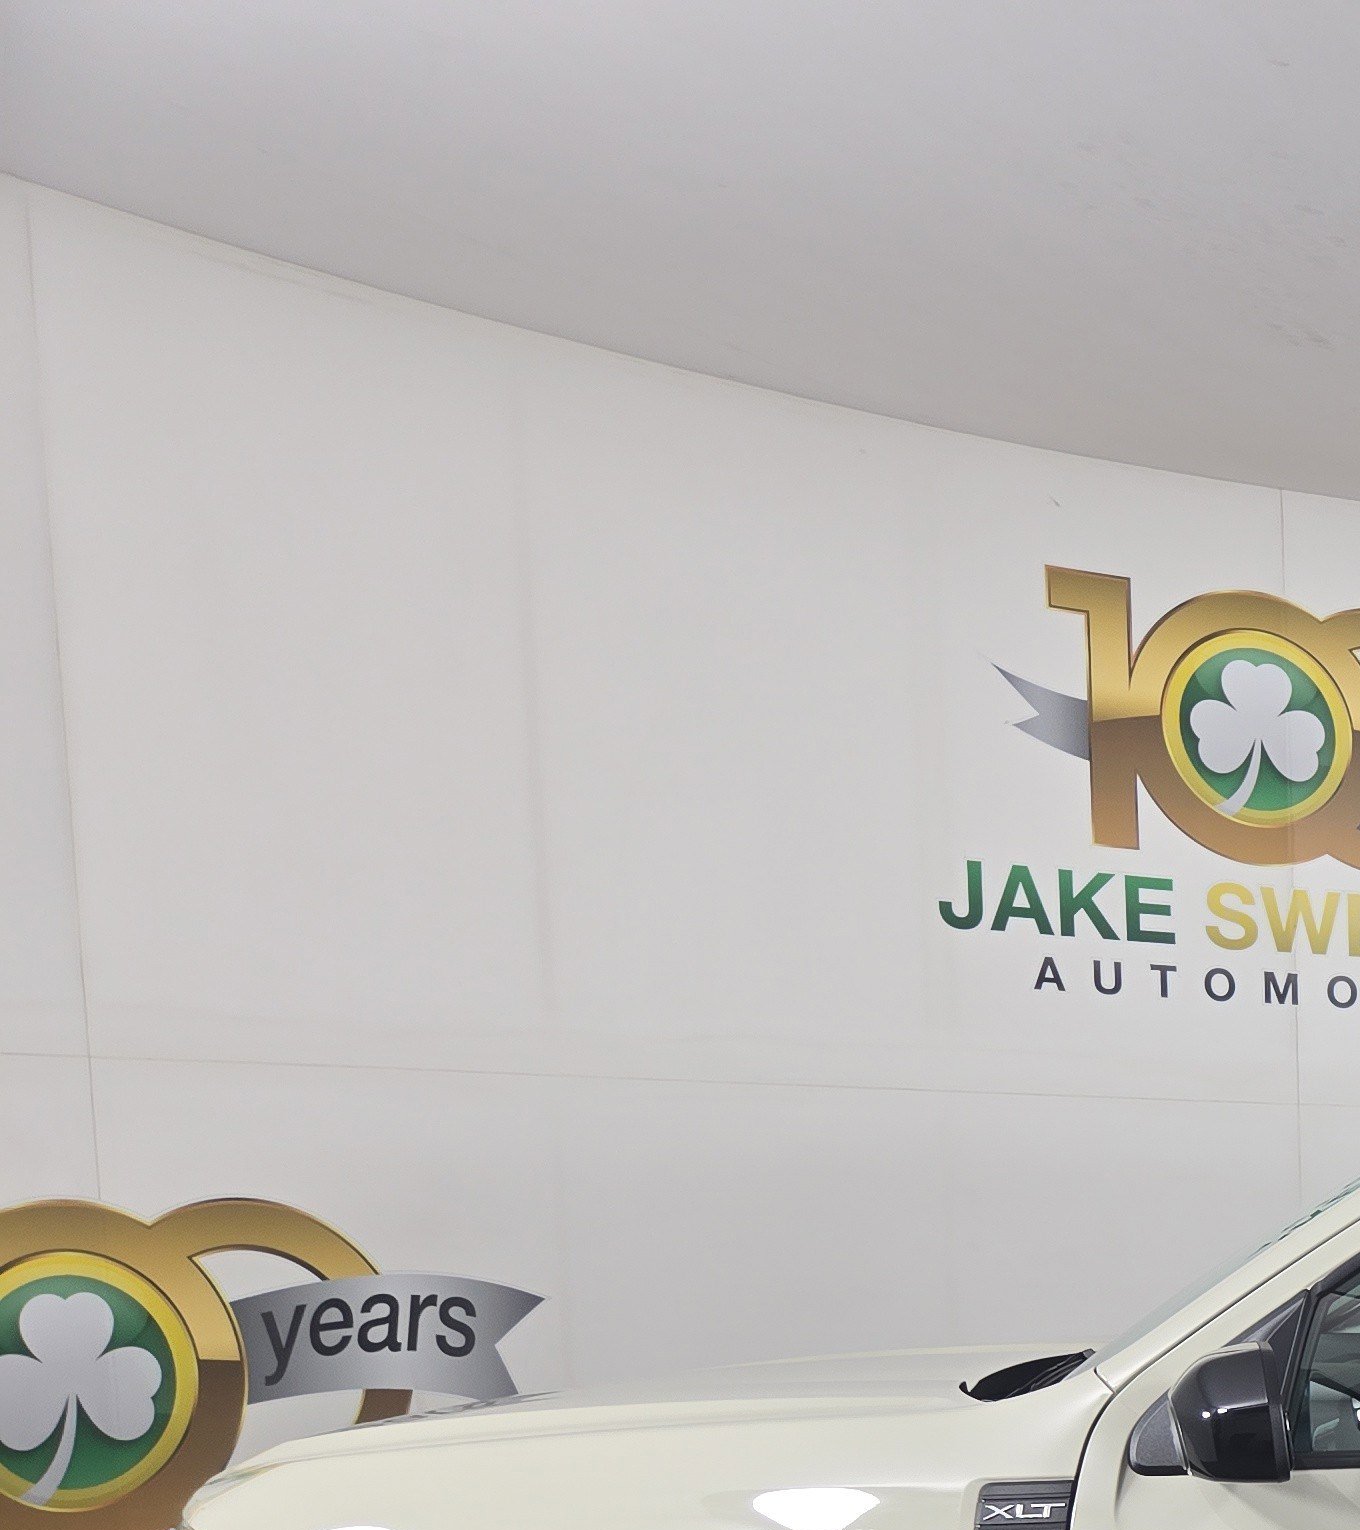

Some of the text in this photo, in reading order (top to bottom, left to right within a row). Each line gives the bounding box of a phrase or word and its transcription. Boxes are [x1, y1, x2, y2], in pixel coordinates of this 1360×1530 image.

[939, 860, 1176, 945] JAKE
[260, 1292, 477, 1387] years
[983, 1502, 1066, 1520] XLT
